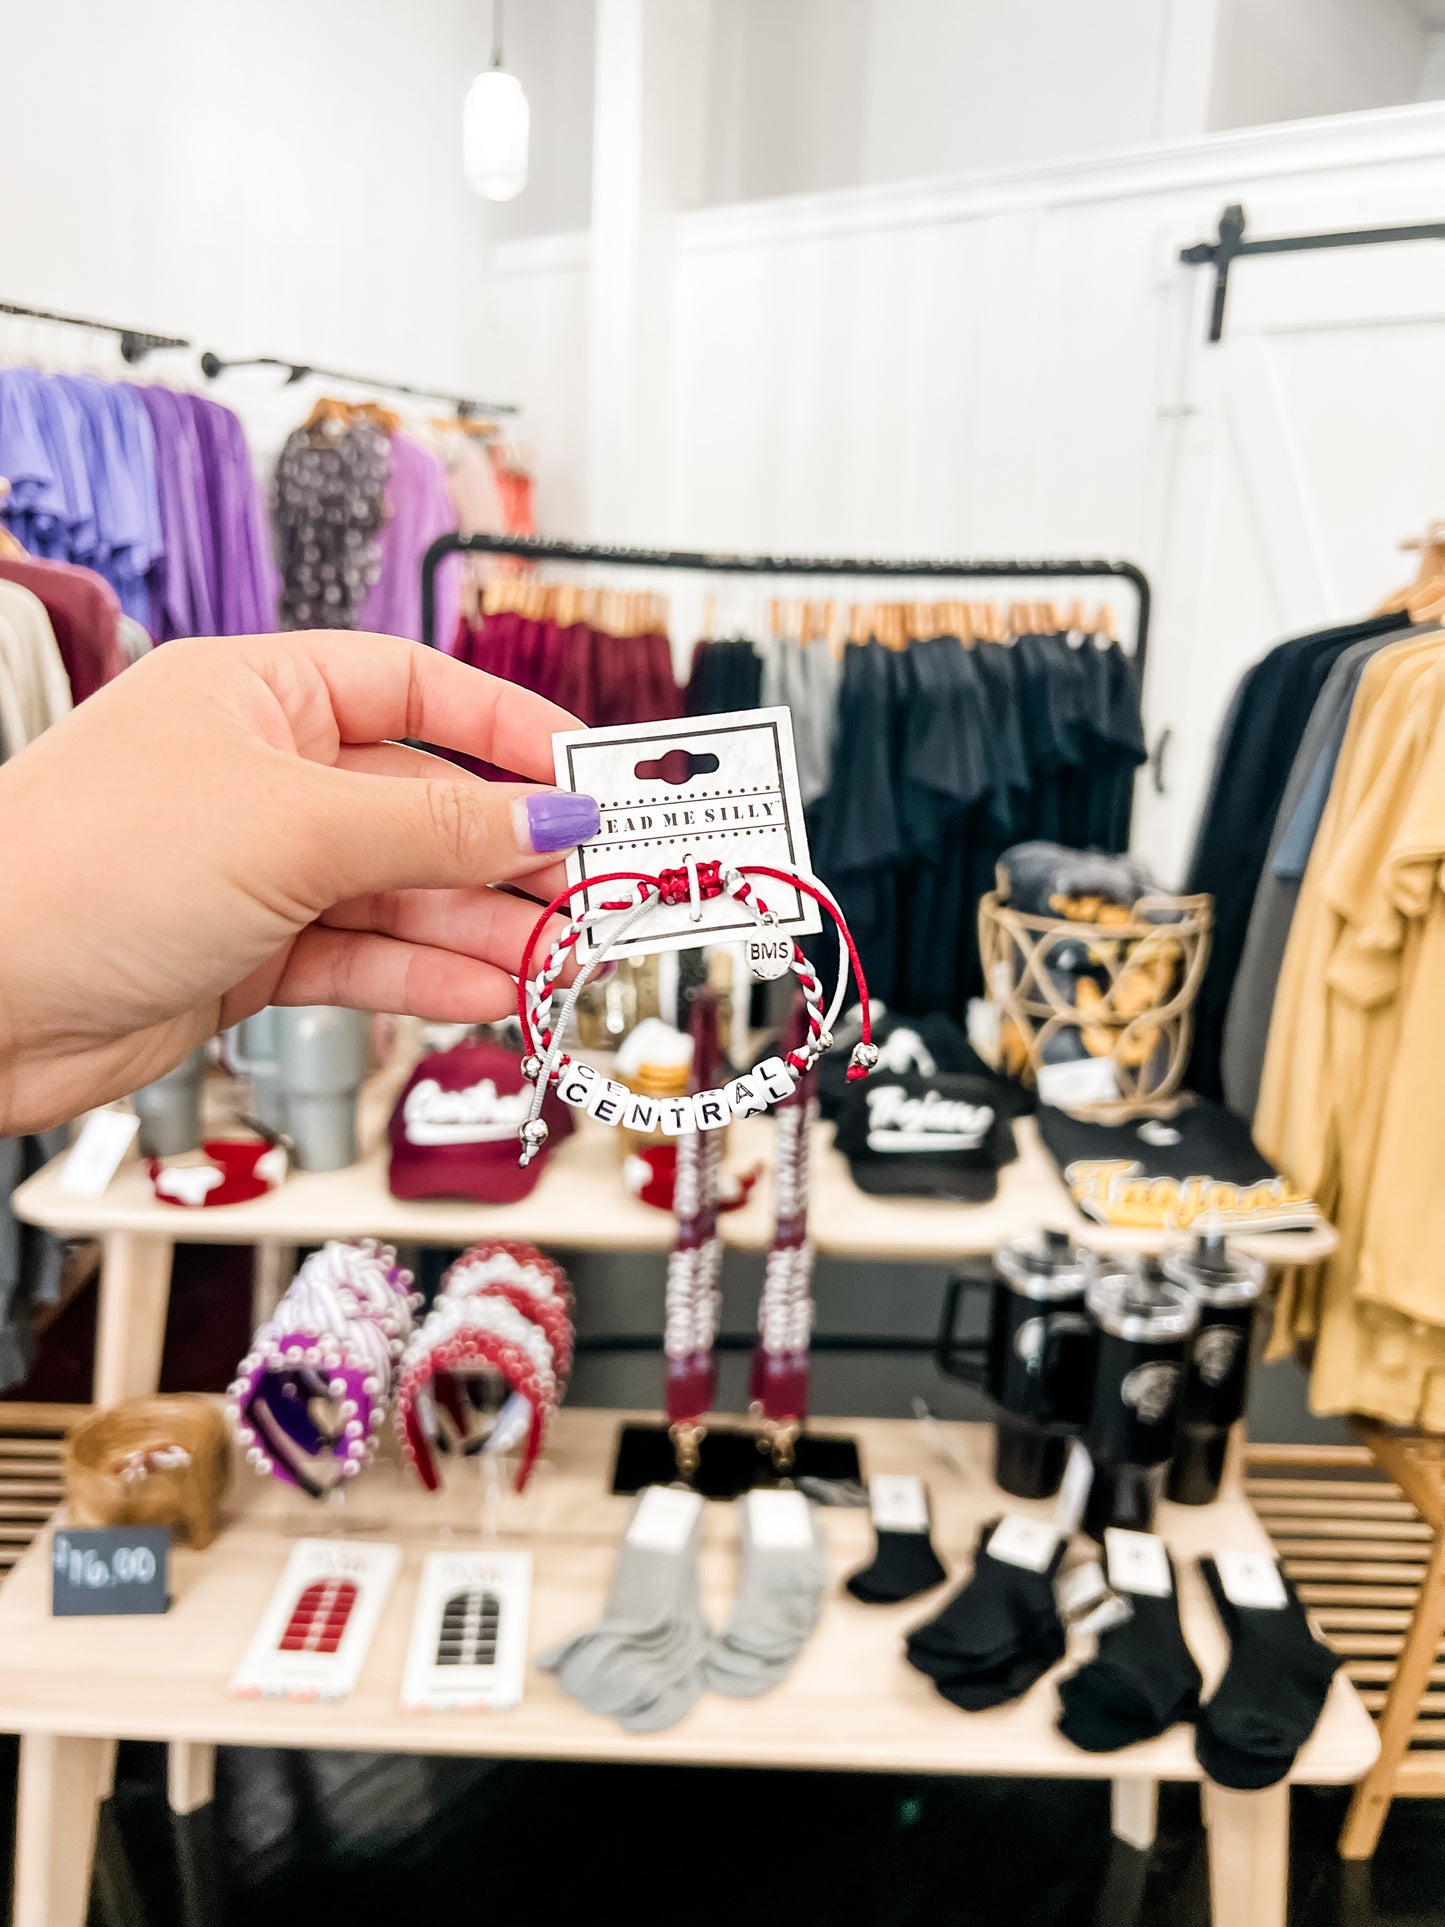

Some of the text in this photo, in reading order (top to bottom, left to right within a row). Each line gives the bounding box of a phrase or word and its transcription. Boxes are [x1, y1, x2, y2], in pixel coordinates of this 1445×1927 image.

[597, 815, 653, 834] EAD
[663, 810, 695, 828] ME
[750, 941, 789, 961] BMS
[565, 1066, 789, 1130] CENTRAL
